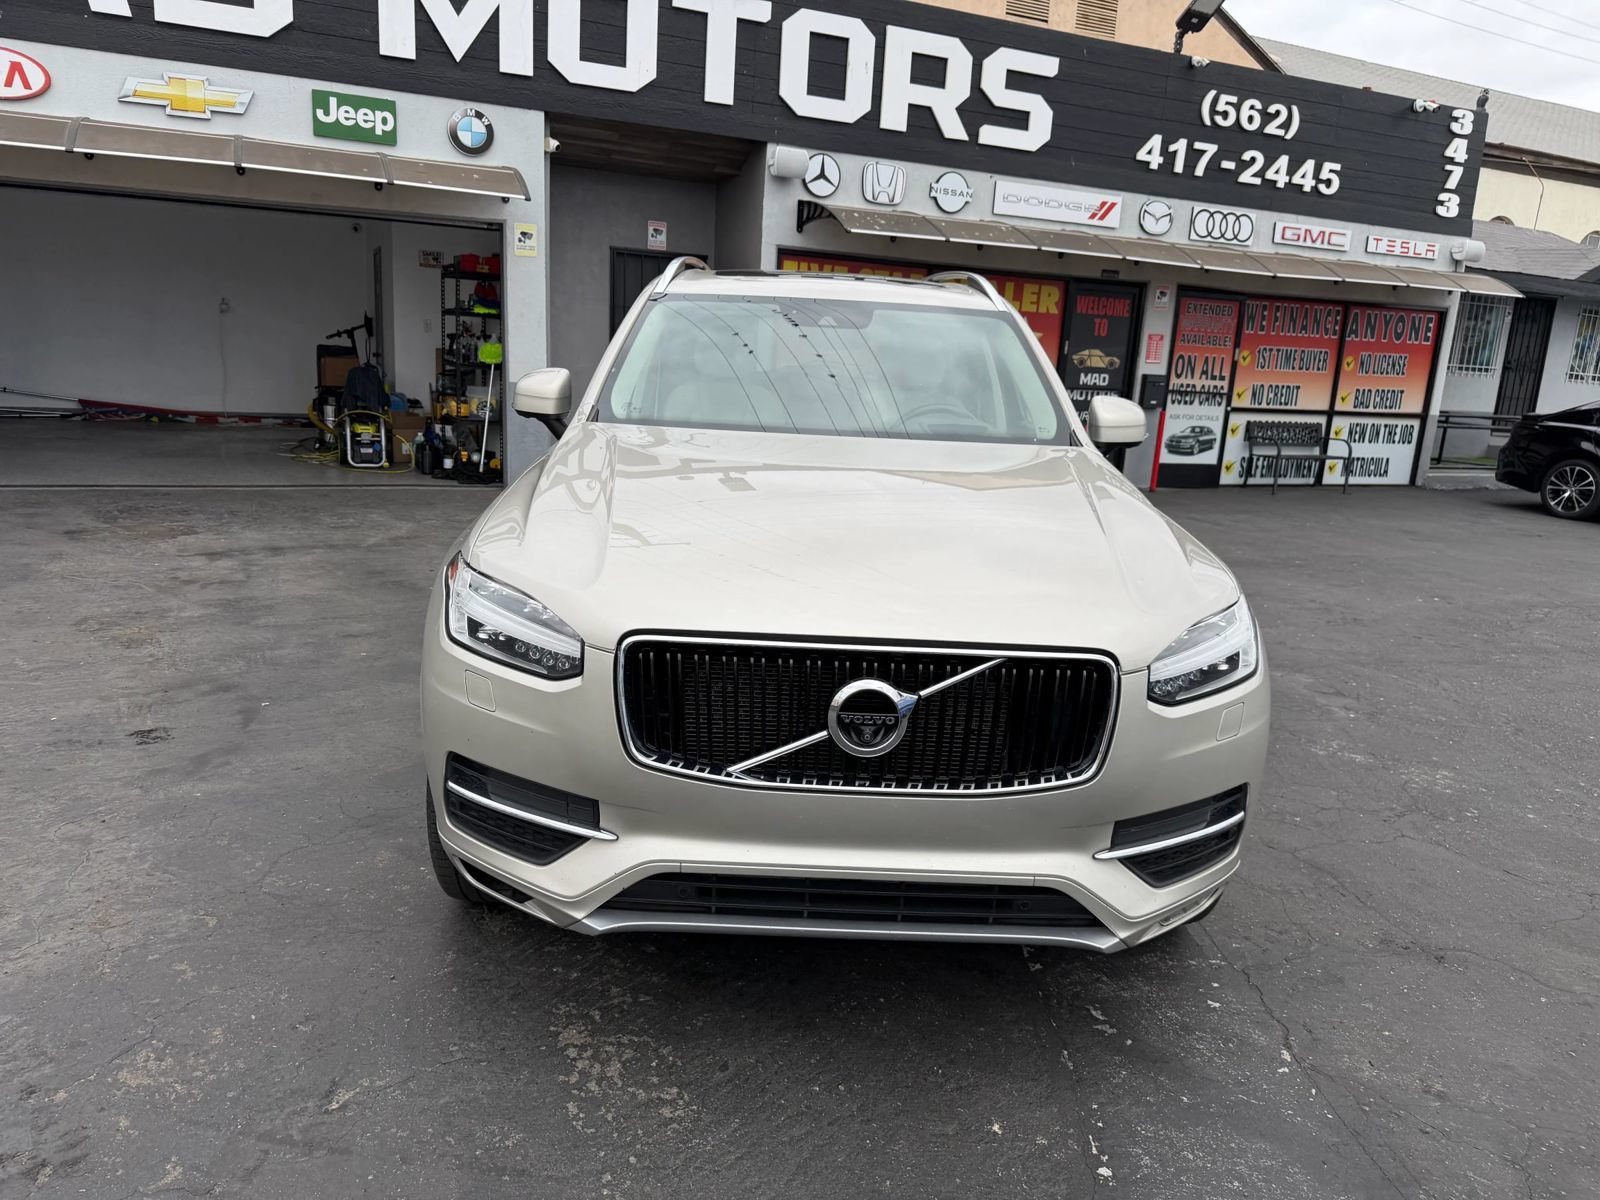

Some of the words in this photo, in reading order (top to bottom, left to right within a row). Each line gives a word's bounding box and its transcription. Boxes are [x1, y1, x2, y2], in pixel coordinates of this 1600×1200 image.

[378, 0, 1061, 152] MOTORS
[316, 96, 395, 136] Jeep
[453, 108, 491, 126] BMW
[1201, 88, 1301, 141] (562)
[1135, 132, 1342, 196] 417-2445
[931, 186, 973, 199] NISSAN
[1002, 192, 1102, 213] DODGE
[1281, 225, 1347, 248] GMC
[1372, 237, 1437, 257] TESLA
[1076, 295, 1131, 317] WELCOME
[1187, 302, 1233, 317] EXTENDED
[1094, 318, 1109, 337] TO
[1245, 301, 1269, 334] WE
[1270, 303, 1342, 339] FINANCE
[1346, 310, 1436, 344] ANYONE
[1174, 353, 1197, 379] ON
[1199, 354, 1226, 381] ALL
[1256, 346, 1274, 371] 1ST
[1274, 347, 1298, 372] TIME
[1298, 348, 1329, 373] BUYER
[1357, 352, 1373, 376] NO
[1372, 353, 1409, 377] LICENSE
[1080, 372, 1109, 386] MAD
[1170, 383, 1197, 406] USED
[1198, 384, 1225, 407] CARS
[1250, 383, 1265, 406] NO
[1265, 384, 1301, 407] CREDIT
[1353, 388, 1373, 409] BAD
[1372, 389, 1405, 410] CREDIT
[1347, 422, 1369, 443] NEW
[1368, 423, 1382, 444] ON
[1382, 424, 1399, 444] THE
[1397, 424, 1415, 445] JOB
